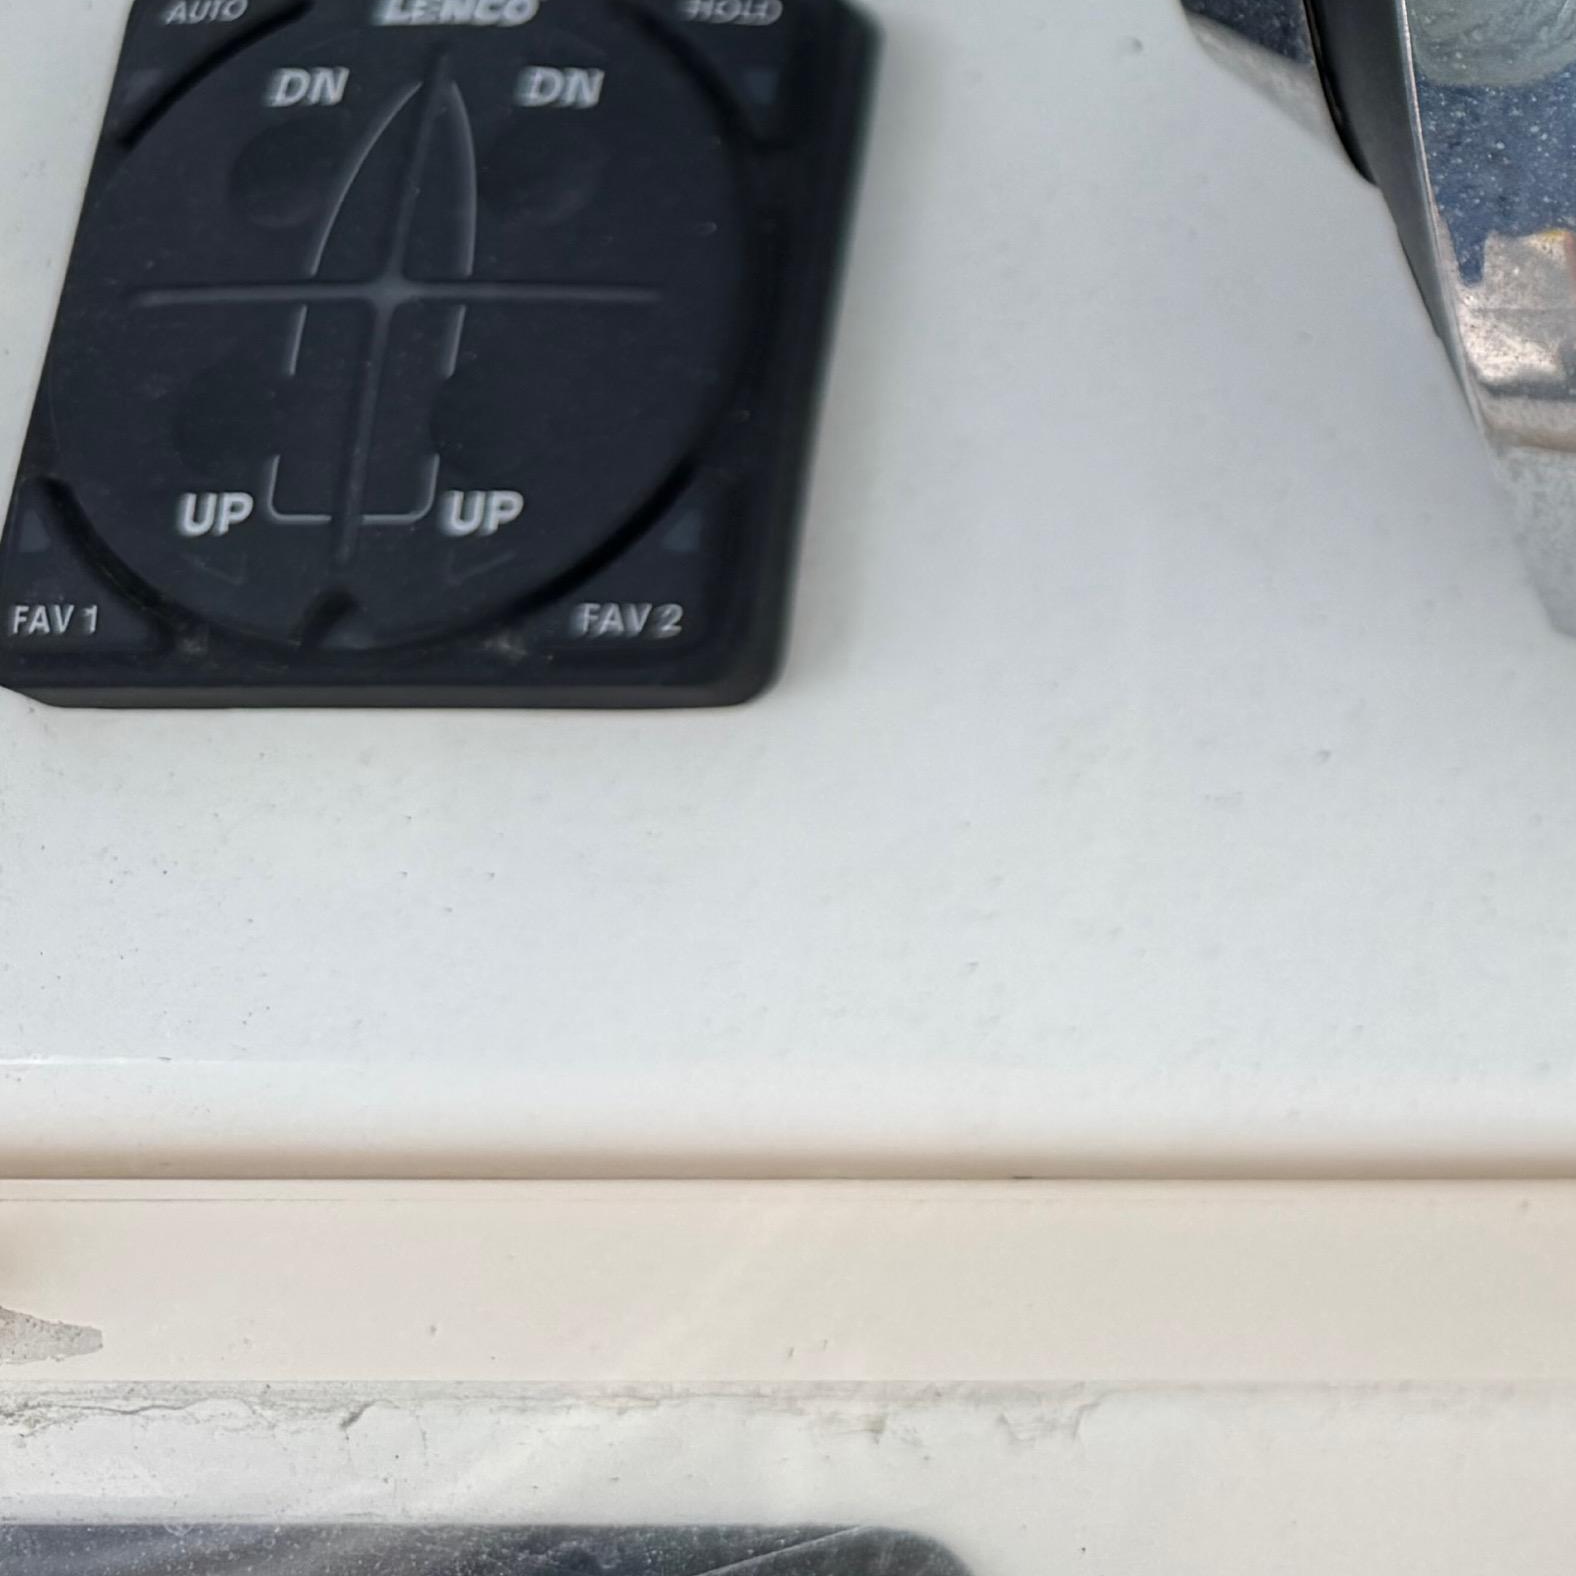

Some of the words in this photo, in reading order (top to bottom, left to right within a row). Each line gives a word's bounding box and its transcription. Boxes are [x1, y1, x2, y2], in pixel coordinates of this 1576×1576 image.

[266, 66, 349, 107] DN
[515, 65, 604, 109] DN
[178, 491, 253, 536] UP
[441, 489, 524, 537] UP
[10, 603, 76, 634] FAV
[82, 604, 100, 633] 1
[575, 603, 652, 636] FAV
[655, 603, 684, 636] 2
